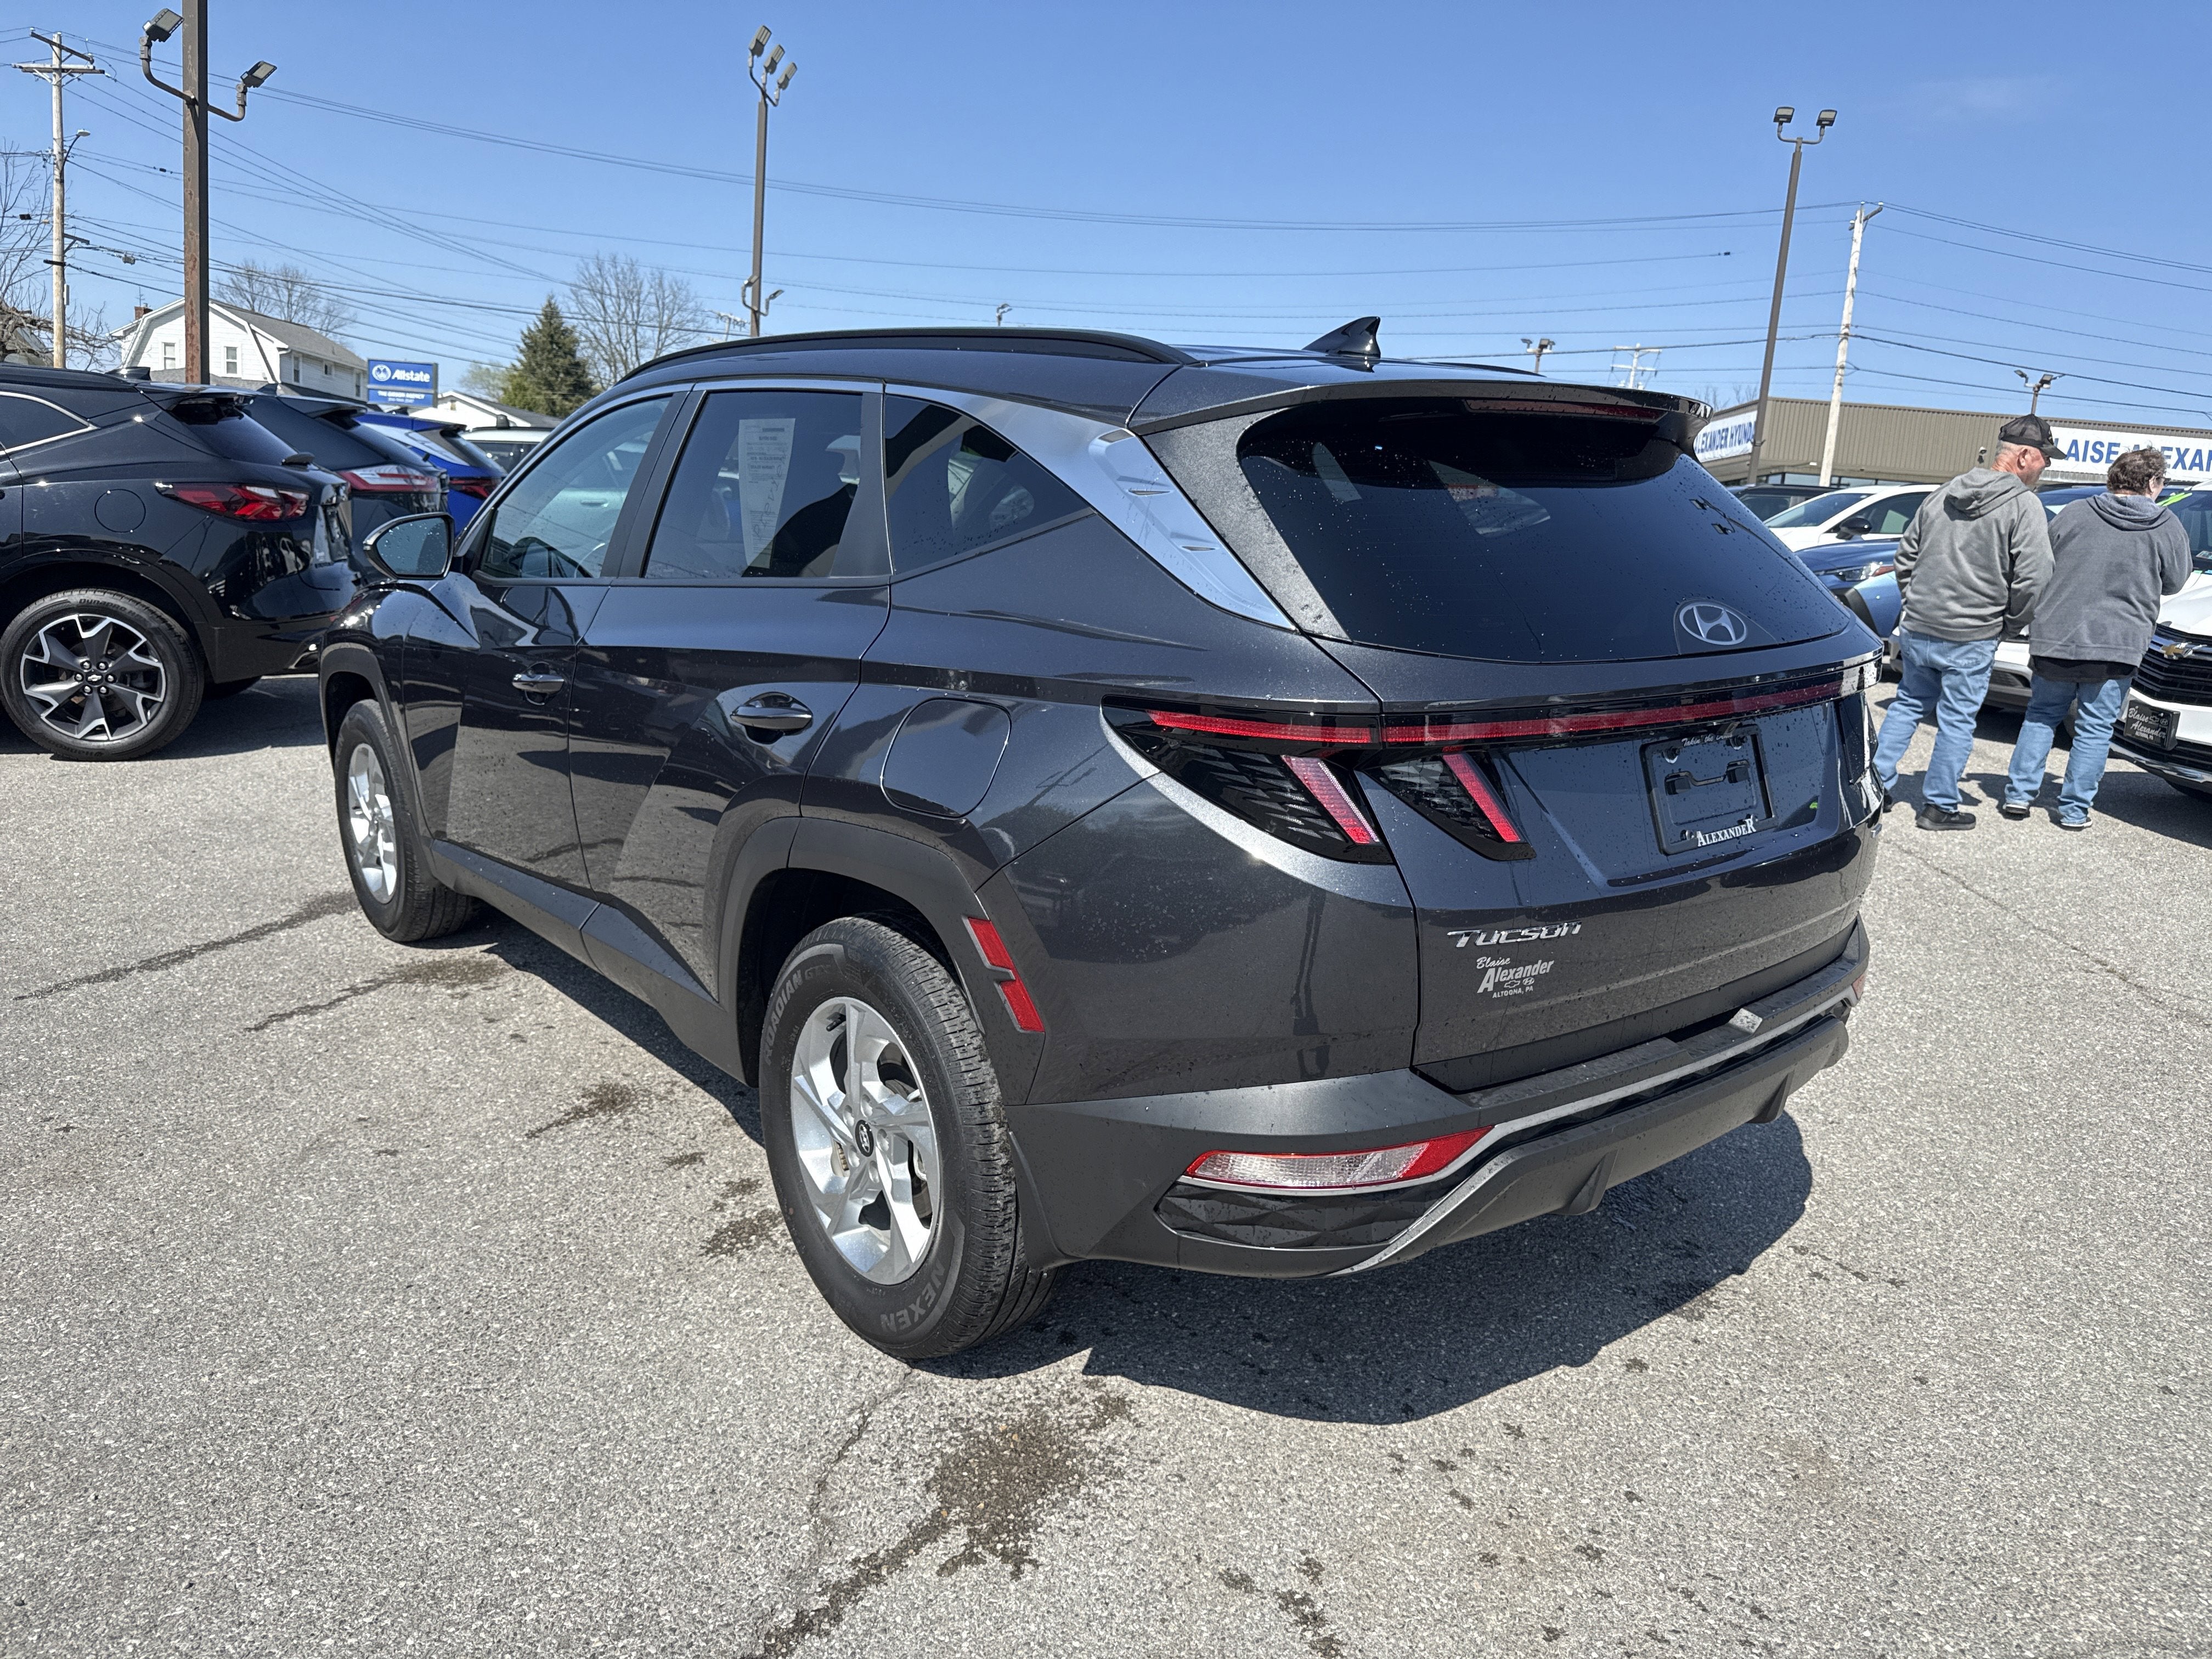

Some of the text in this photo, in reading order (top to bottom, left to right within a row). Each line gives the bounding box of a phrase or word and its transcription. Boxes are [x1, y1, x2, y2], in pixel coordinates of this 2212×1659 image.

[392, 369, 430, 382] Allstate
[1695, 428, 1729, 454] LEXANDER
[2053, 438, 2121, 465] AISE
[2128, 706, 2149, 723] Blaise
[1704, 733, 1714, 743] the
[2130, 720, 2166, 738] Alexander
[1697, 818, 1757, 847] ALEXANDER
[1447, 922, 1582, 947] TUCSON
[1476, 956, 1511, 969] Blaise
[1477, 960, 1555, 994] Alexander
[1492, 987, 1524, 998] ALTOONA,
[765, 969, 803, 1066] ROADIAN
[881, 1259, 945, 1332] NEXEN
